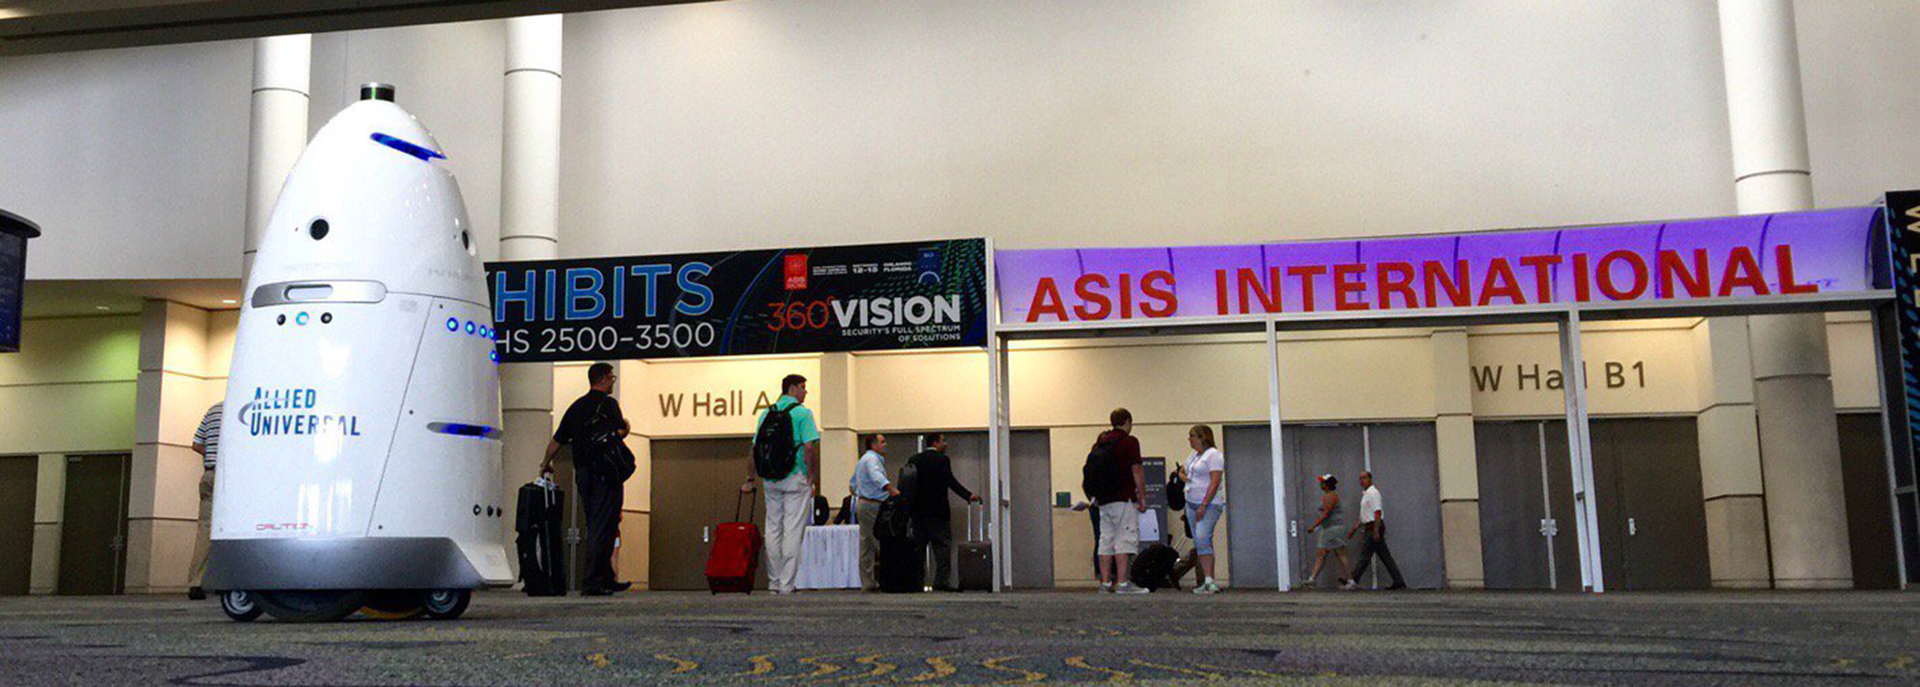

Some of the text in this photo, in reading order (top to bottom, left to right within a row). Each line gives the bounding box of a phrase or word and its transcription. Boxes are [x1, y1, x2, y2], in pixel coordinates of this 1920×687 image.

[485, 261, 715, 323] HIBITS
[1026, 244, 1819, 323] ASIS INTERNATIONAL
[831, 294, 962, 328] VISION
[540, 322, 715, 353] 2500-3500
[842, 324, 961, 336] SECURITY'S FULL SPECTRUM
[912, 333, 961, 342] SOLUTIONS
[1471, 360, 1645, 392] W Hal B1
[252, 386, 317, 411] ALLIED
[658, 389, 772, 418] W Hall A
